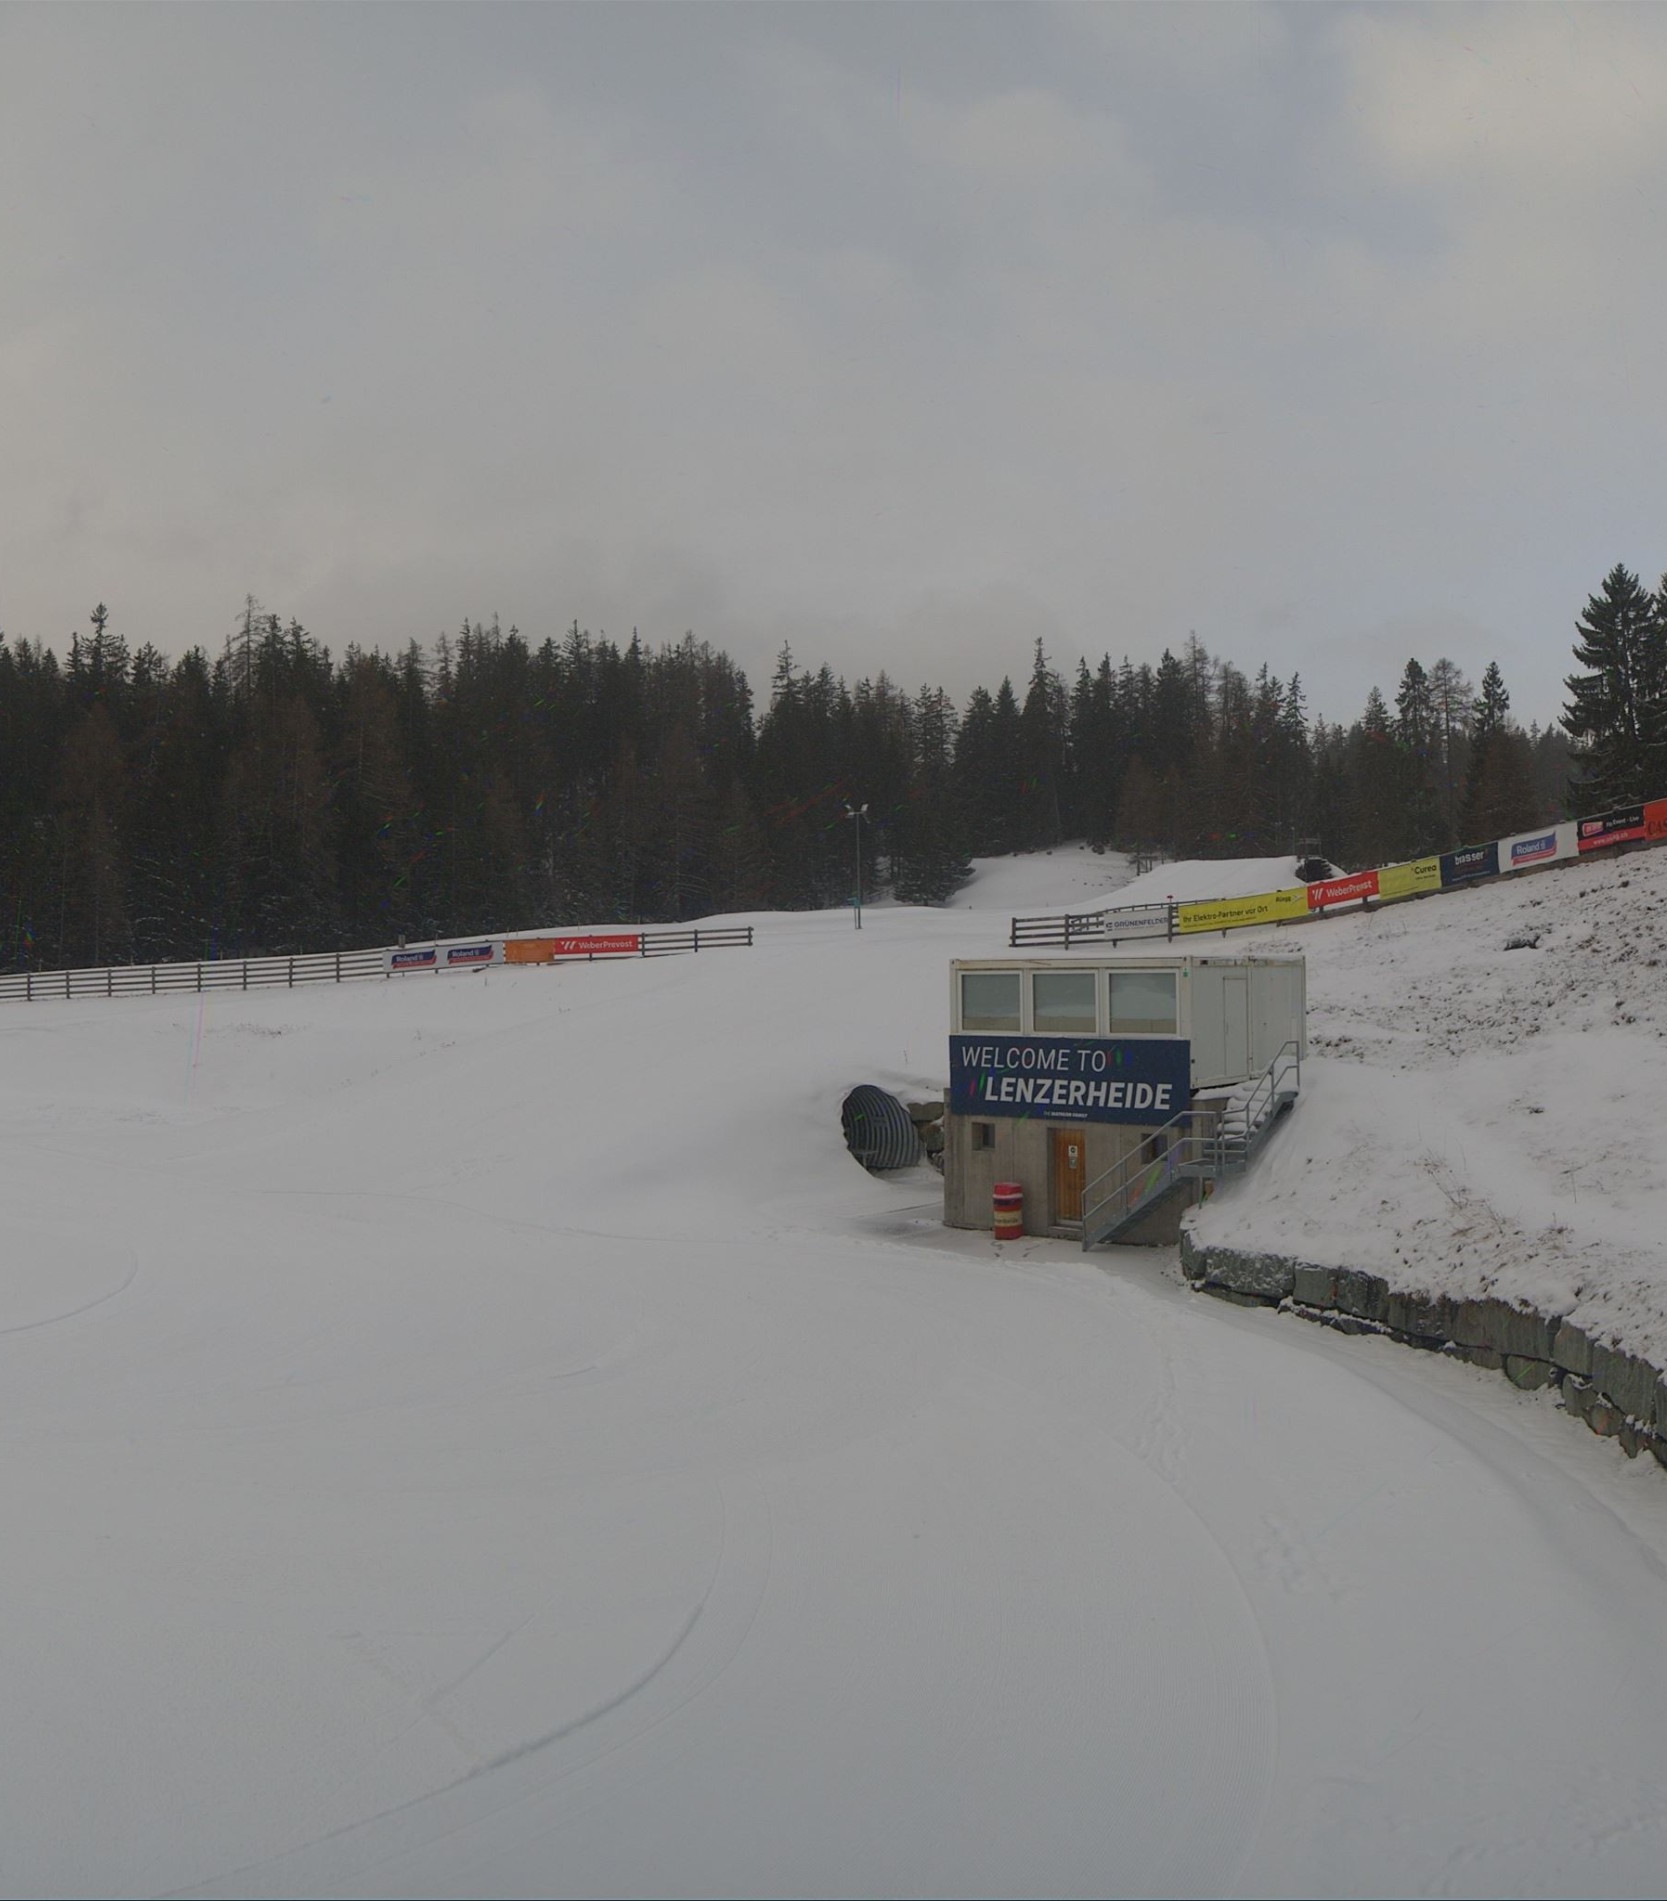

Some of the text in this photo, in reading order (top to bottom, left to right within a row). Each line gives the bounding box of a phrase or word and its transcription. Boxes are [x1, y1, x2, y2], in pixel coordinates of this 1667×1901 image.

[1516, 842, 1540, 855] Roland
[578, 939, 633, 949] WeberPrevost
[396, 953, 418, 962] Roland
[452, 949, 474, 958] Roland
[961, 1046, 1107, 1072] WELCOME TO
[985, 1076, 1173, 1110] LENZERHEIDE
